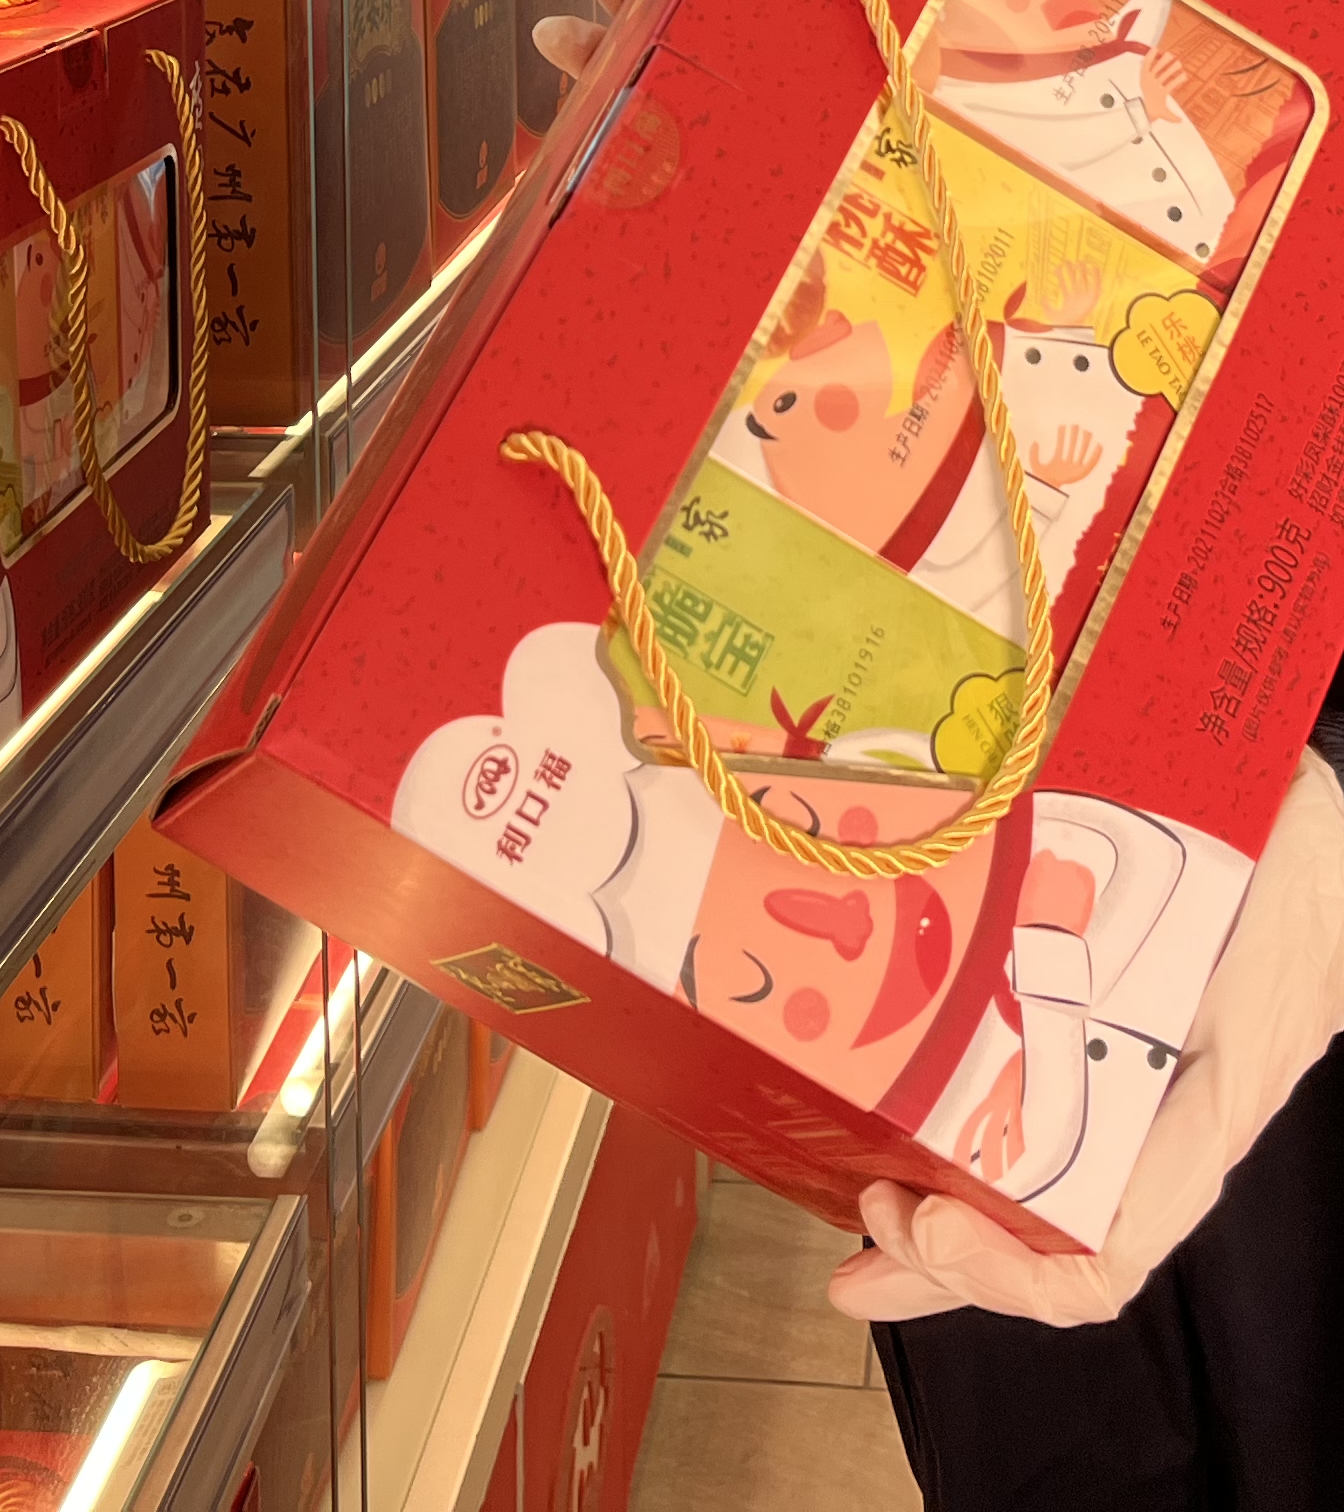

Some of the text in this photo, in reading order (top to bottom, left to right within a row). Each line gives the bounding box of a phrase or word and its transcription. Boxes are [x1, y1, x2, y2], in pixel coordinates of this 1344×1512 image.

[1136, 329, 1153, 348] LE
[1148, 345, 1172, 376] TAO
[1195, 516, 1312, 747] 净含量/规格:900克
[492, 747, 575, 868] 利口福
